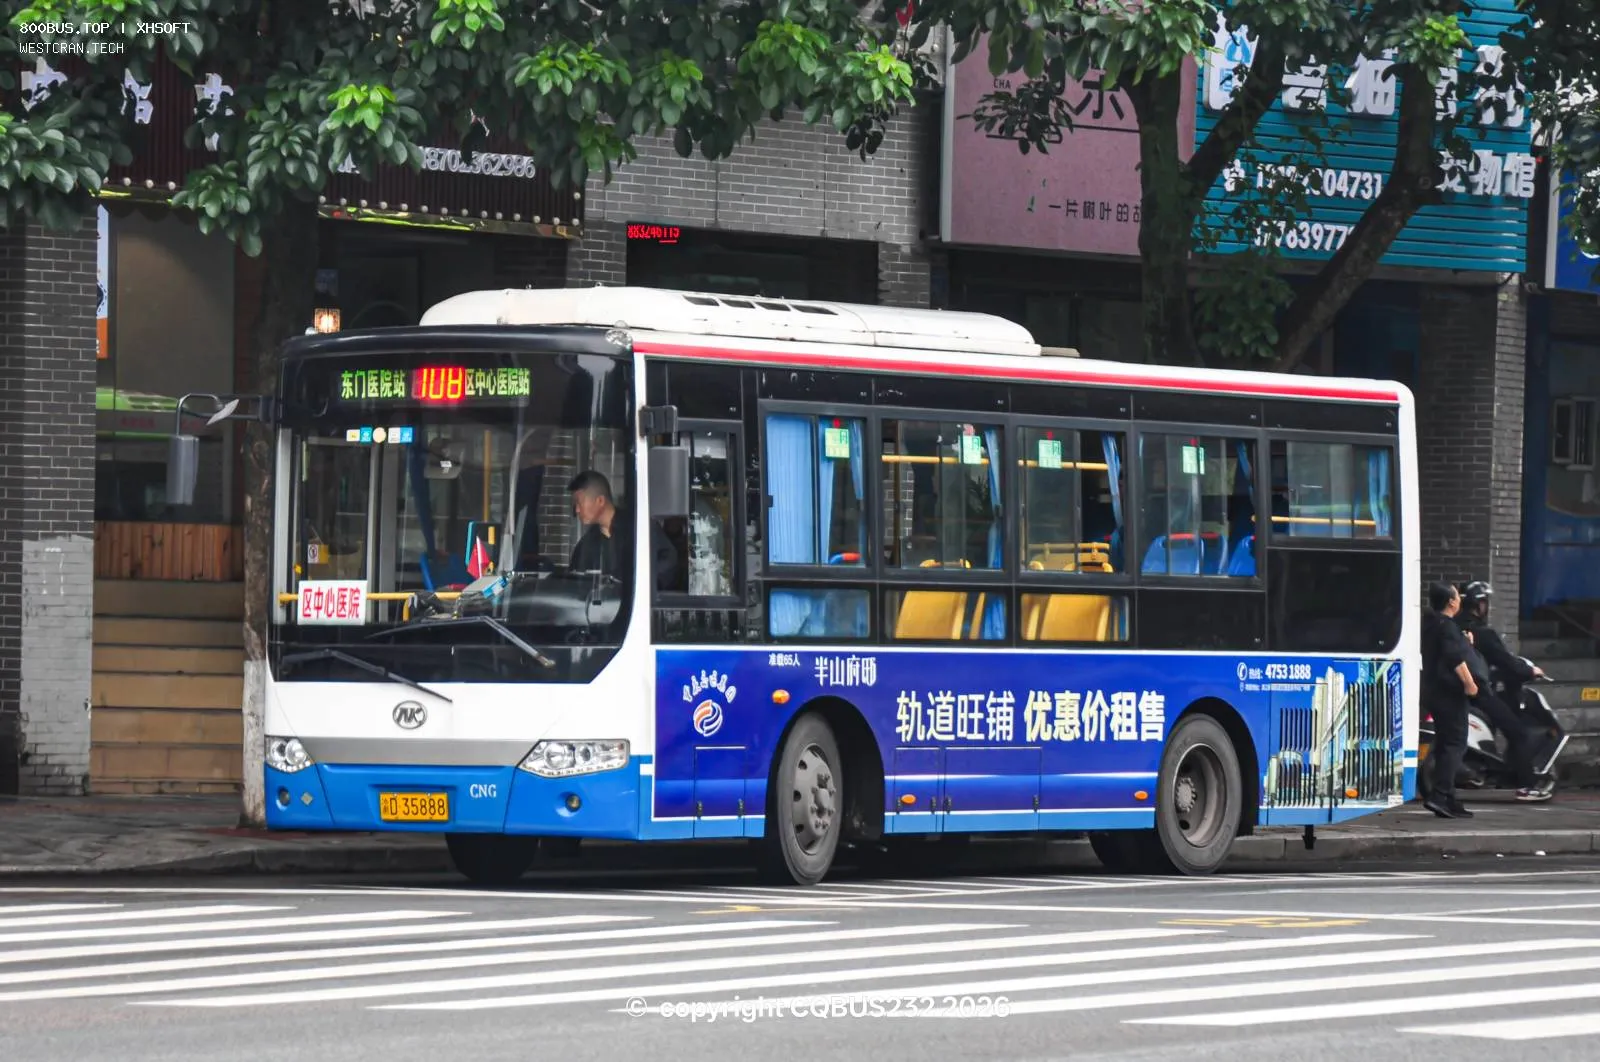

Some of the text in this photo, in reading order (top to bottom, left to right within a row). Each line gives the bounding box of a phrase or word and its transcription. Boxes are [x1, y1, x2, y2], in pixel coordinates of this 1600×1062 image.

[340, 369, 406, 399] 东门医院站
[464, 367, 530, 396] 区中心医院站
[302, 587, 361, 619] 区中心医院
[896, 690, 1165, 742] 轨道旺铺 优惠价租售
[469, 784, 497, 799] CNG
